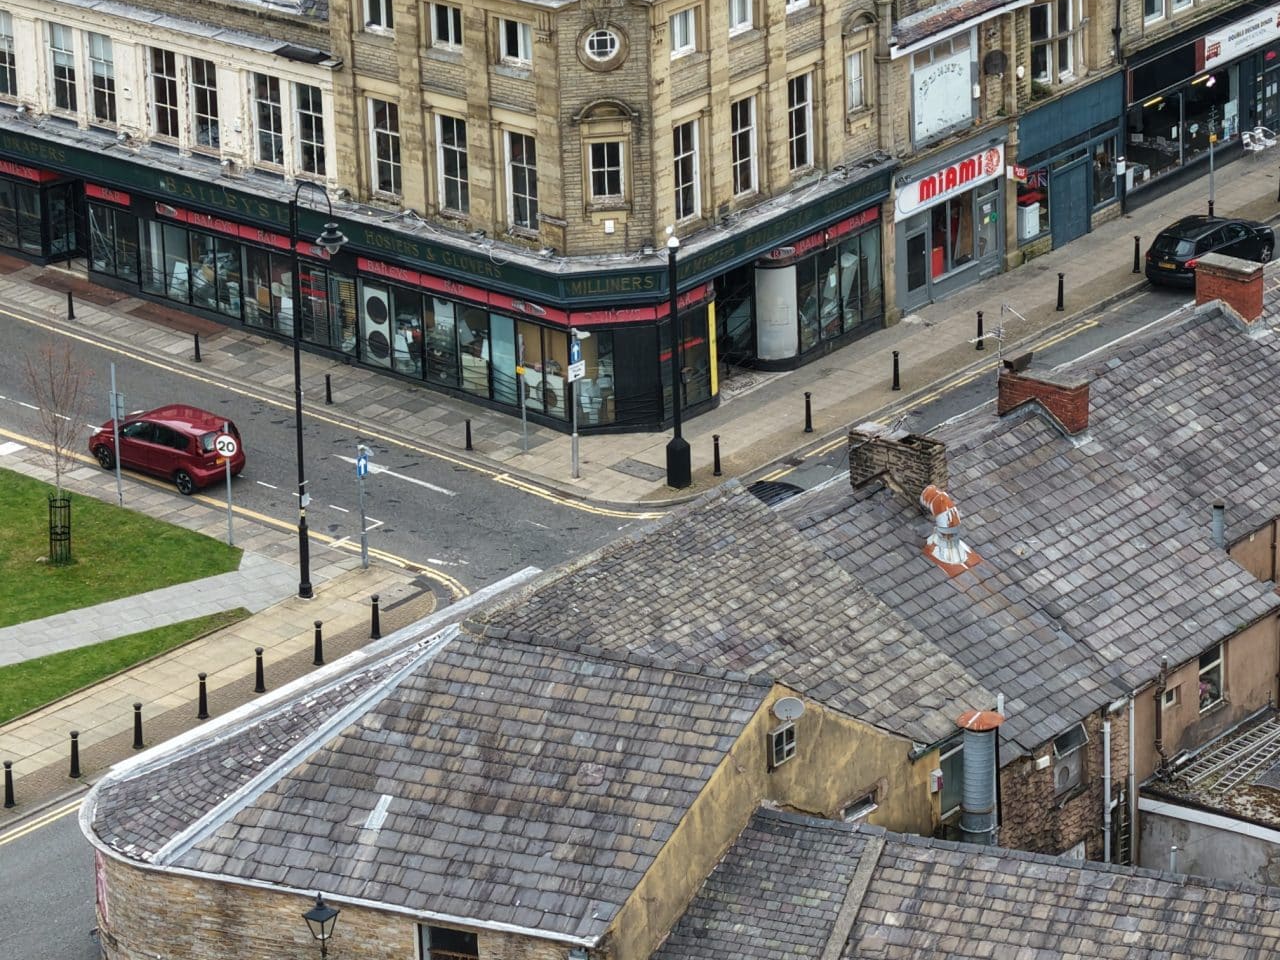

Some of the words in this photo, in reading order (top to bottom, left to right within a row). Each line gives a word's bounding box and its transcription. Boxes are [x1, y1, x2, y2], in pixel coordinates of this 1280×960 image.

[364, 231, 420, 257] HOSIERS
[571, 276, 654, 295] MILLINERS
[217, 440, 236, 453] 20
